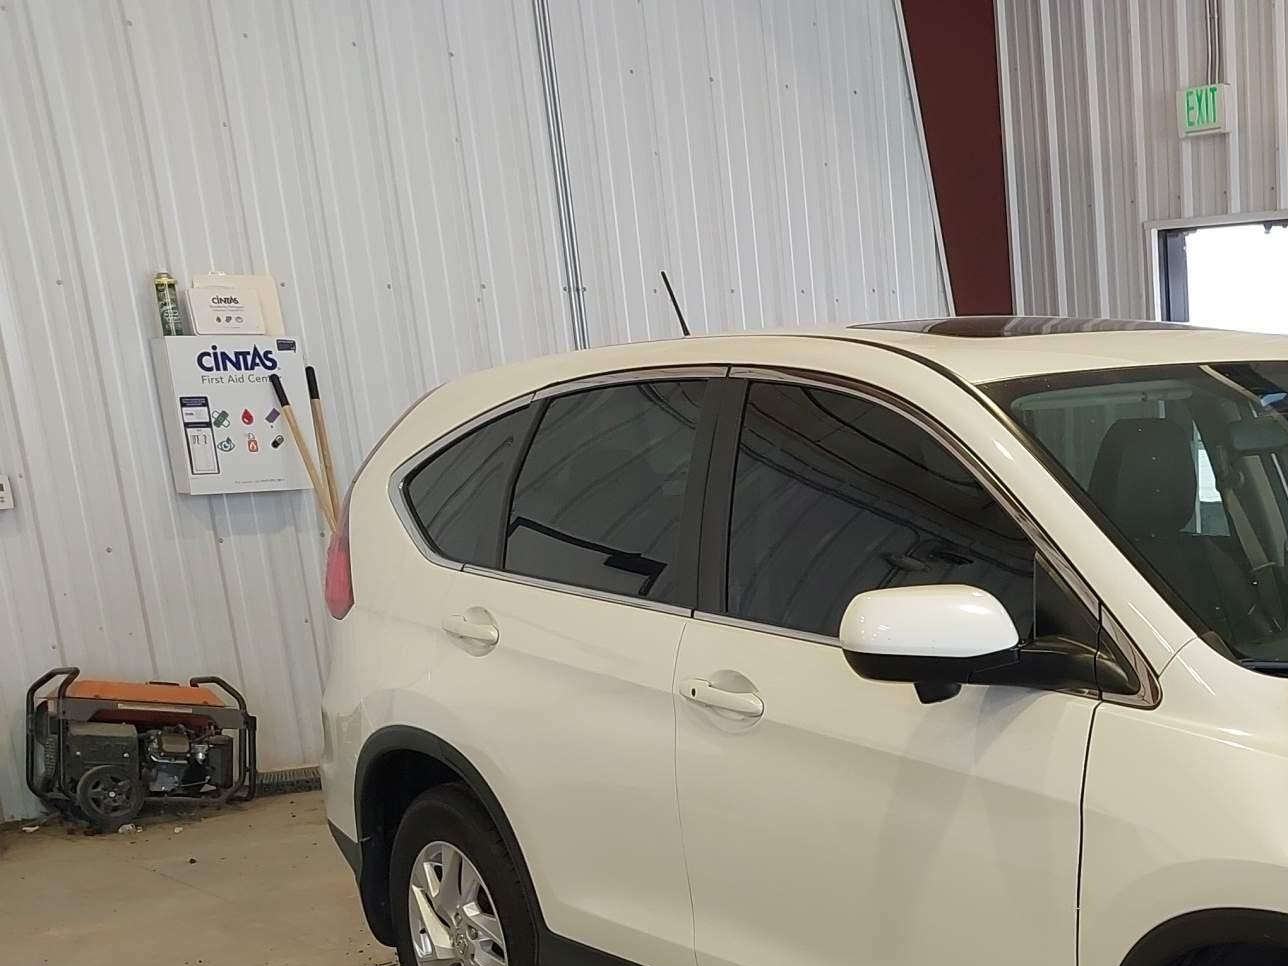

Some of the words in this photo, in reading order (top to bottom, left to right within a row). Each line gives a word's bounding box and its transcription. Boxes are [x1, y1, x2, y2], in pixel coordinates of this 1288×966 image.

[1186, 87, 1217, 127] EXIT
[201, 375, 224, 384] First
[227, 374, 245, 383] Aid
